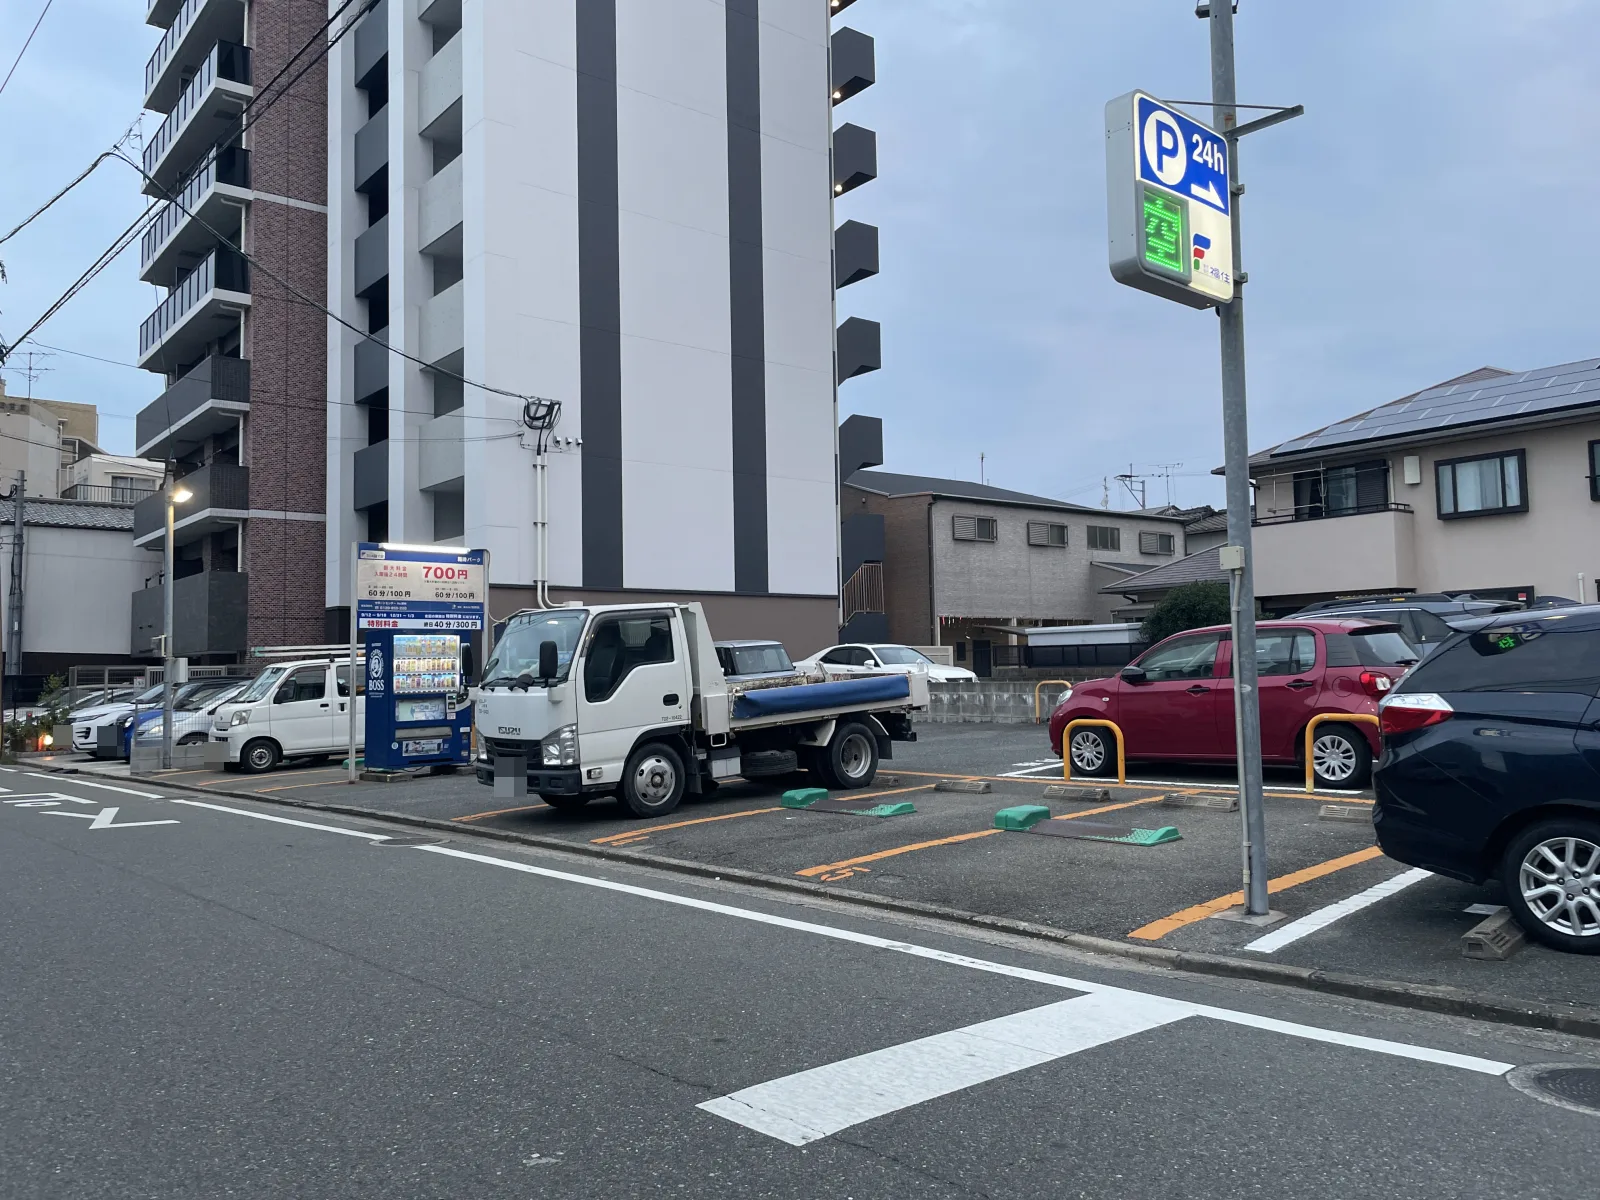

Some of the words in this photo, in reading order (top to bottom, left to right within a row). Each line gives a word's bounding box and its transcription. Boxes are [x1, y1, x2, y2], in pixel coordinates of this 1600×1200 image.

[1155, 118, 1179, 174] P
[1192, 133, 1225, 175] 24h
[1143, 199, 1180, 272] 空
[422, 566, 468, 580] 700円
[368, 679, 384, 690] BOSS
[498, 726, 521, 735] ISUZU
